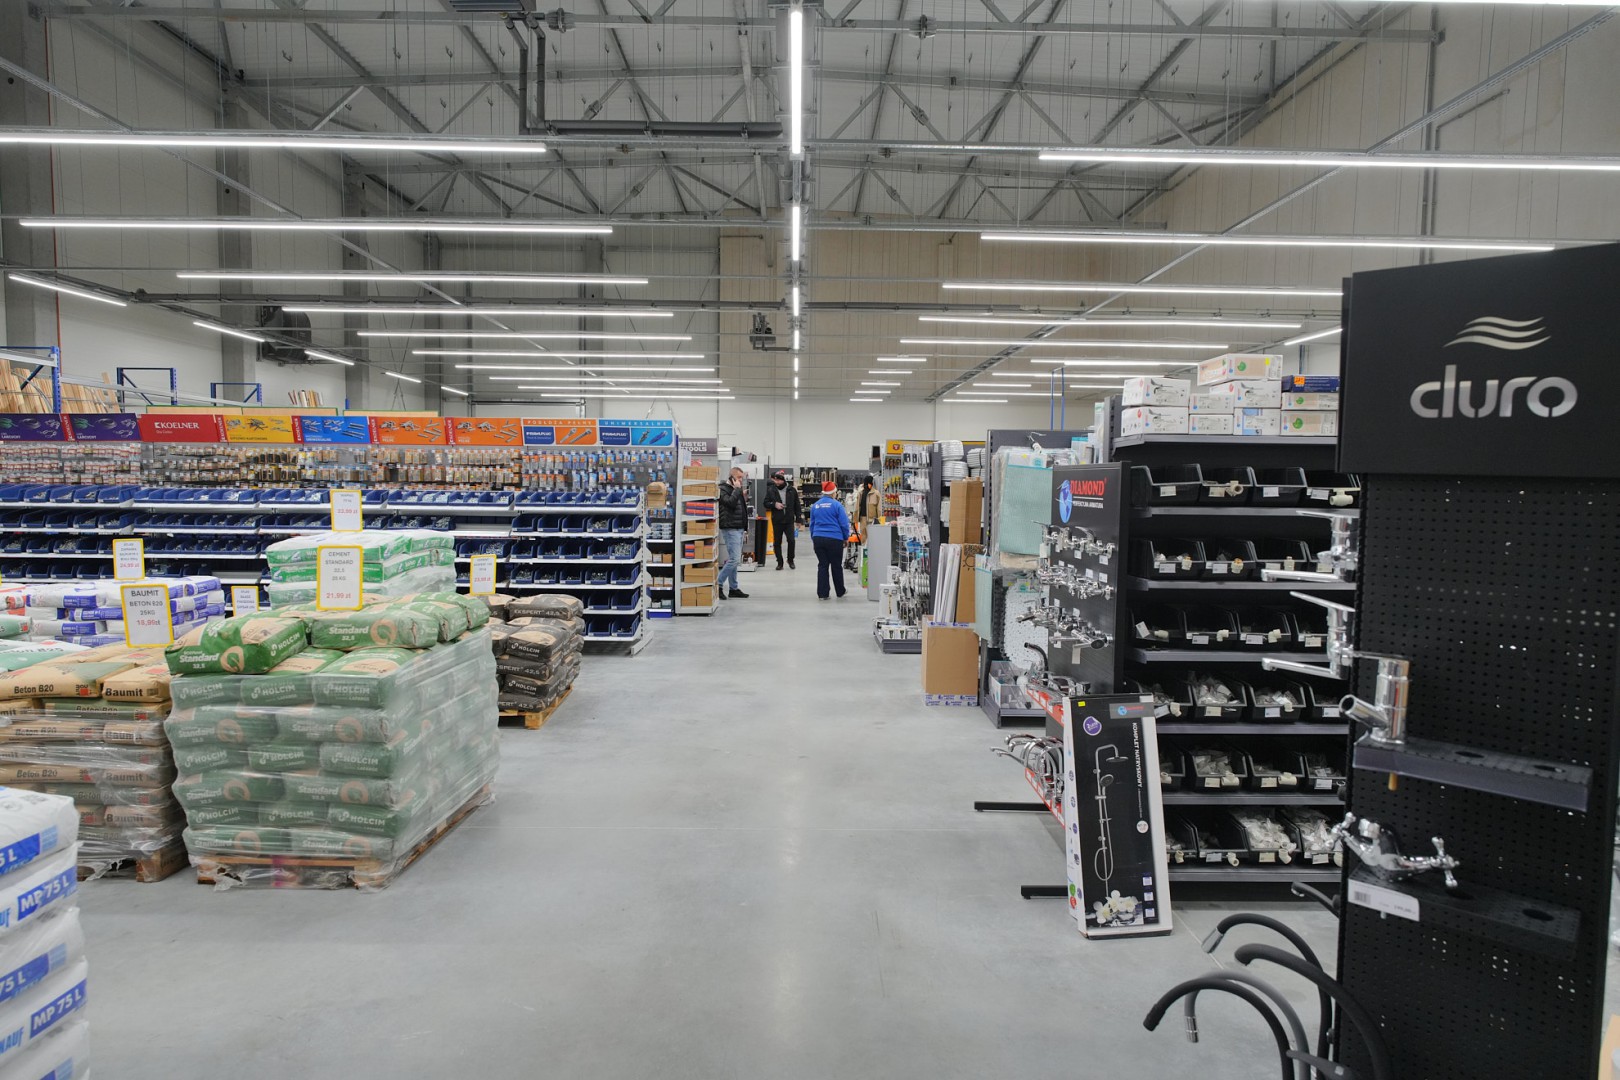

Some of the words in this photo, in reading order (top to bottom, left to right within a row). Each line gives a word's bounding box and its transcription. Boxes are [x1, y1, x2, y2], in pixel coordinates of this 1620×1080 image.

[1409, 364, 1578, 419] duro
[1070, 480, 1105, 496] DIAMOND
[328, 624, 370, 634] Standard
[278, 632, 300, 650] HOLCIM
[518, 645, 540, 653] HOLCIM
[179, 652, 220, 663] Standard
[14, 686, 37, 695] Beton
[38, 684, 55, 693] B20
[105, 687, 144, 697] Baumit
[190, 683, 223, 696] HOLCIM
[262, 684, 296, 696] HOLCIM
[335, 686, 370, 695] HOLCIM
[515, 683, 537, 691] HOLCIM
[179, 727, 215, 738] Standard
[1131, 722, 1140, 748] KOMPLET
[195, 750, 227, 763] HOLCIM
[271, 751, 305, 761] HOLCIM
[343, 756, 379, 765] HOLCIM
[16, 769, 40, 778] Beton
[42, 769, 58, 778] B20
[1134, 749, 1143, 788] NATRYSKOWY
[105, 773, 144, 782] Baumit
[186, 788, 222, 800] Standard
[298, 785, 339, 796] Standard
[106, 814, 144, 822] Baumit
[206, 807, 239, 820] HOLCIM
[280, 811, 314, 819] HOLCIM
[350, 815, 386, 826] HOLCIM
[302, 840, 343, 849] Standard
[8, 848, 18, 863] L
[20, 889, 44, 913] MP
[44, 879, 61, 898] 75
[62, 875, 71, 888] L
[17, 971, 26, 985] L
[33, 1006, 56, 1031] MP
[57, 994, 73, 1014] 75
[74, 988, 82, 1001] L
